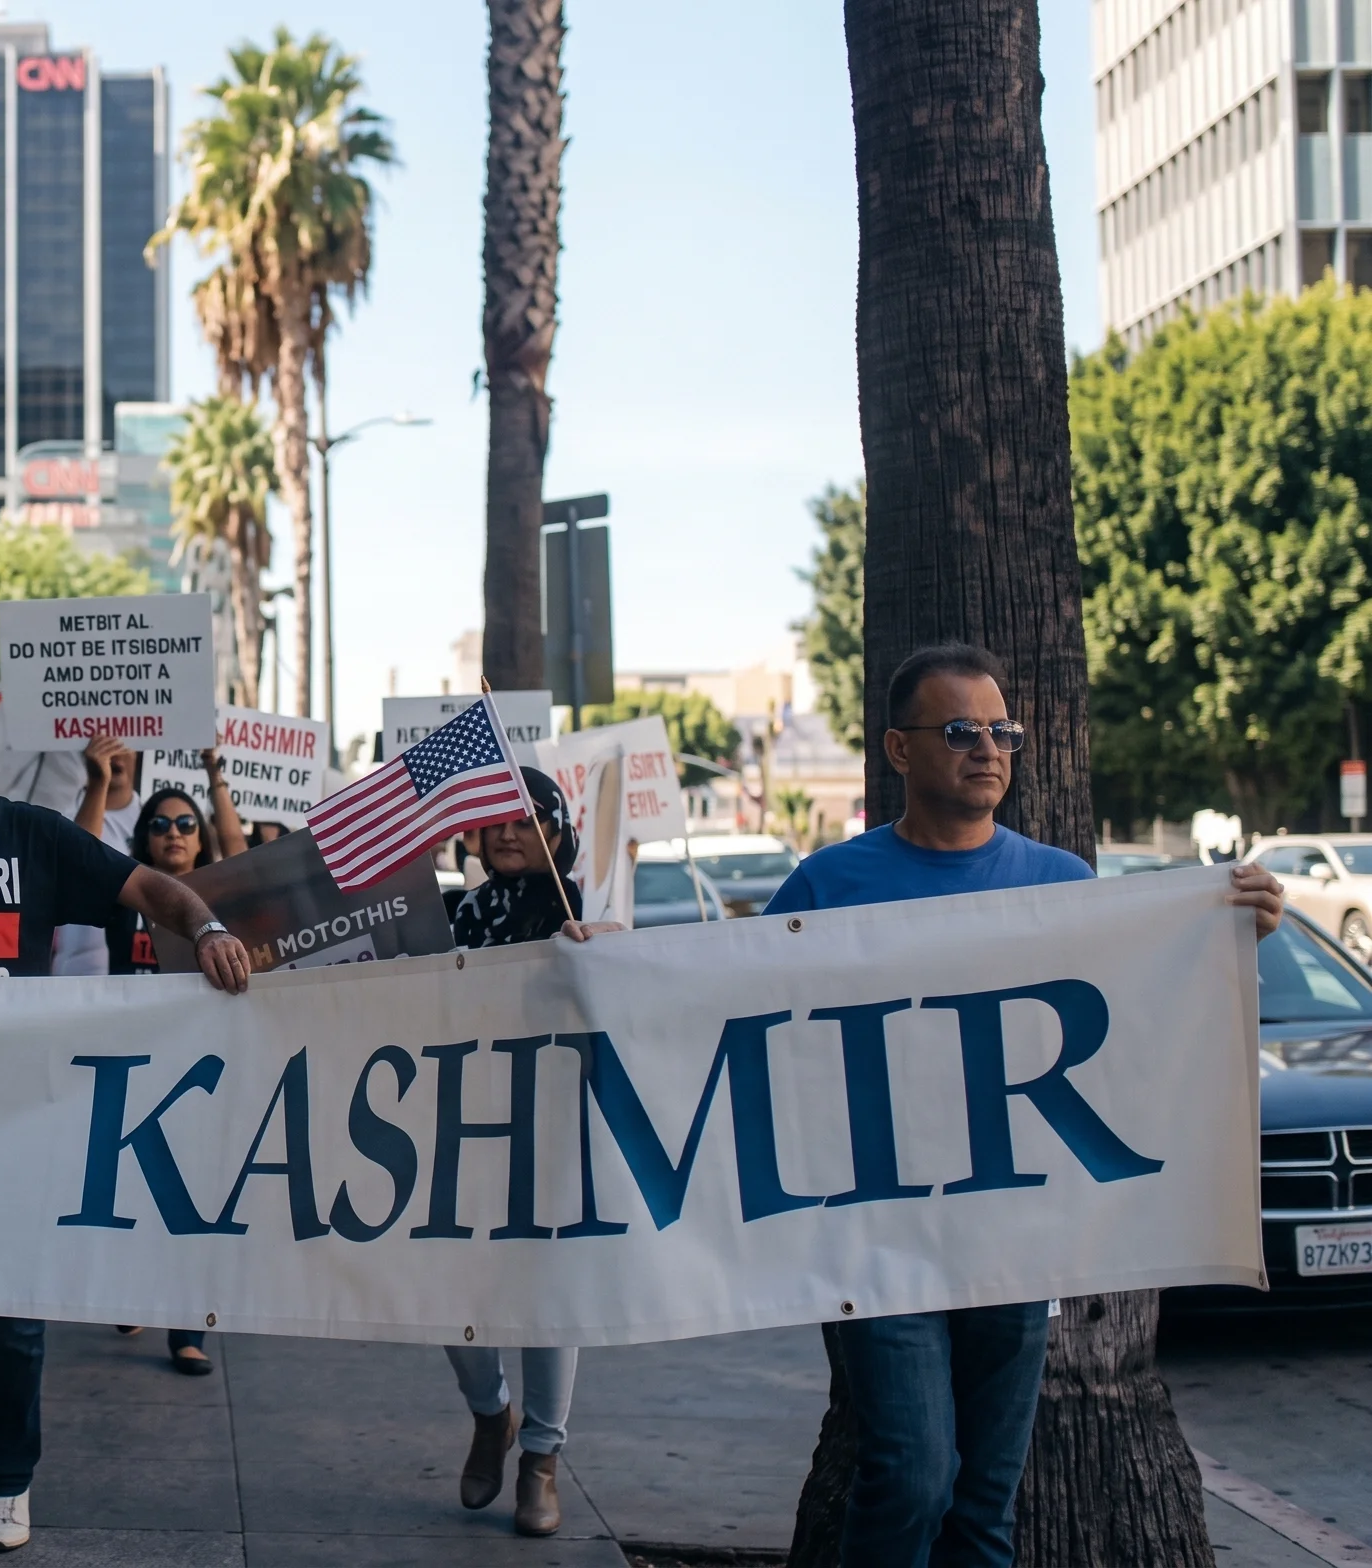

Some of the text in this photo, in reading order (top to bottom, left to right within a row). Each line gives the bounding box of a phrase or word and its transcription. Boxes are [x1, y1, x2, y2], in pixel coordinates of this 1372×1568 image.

[17, 56, 85, 92] CNN
[9, 643, 34, 659] DO
[40, 641, 76, 658] NOT
[82, 640, 105, 656] BE
[43, 666, 84, 682] AMD
[157, 663, 170, 680] A
[155, 689, 172, 705] IN
[224, 717, 316, 759] KASHMIR
[289, 769, 311, 786] OF
[277, 896, 408, 958] MOTOTHIS
[57, 978, 1165, 1242] KASHMIR
